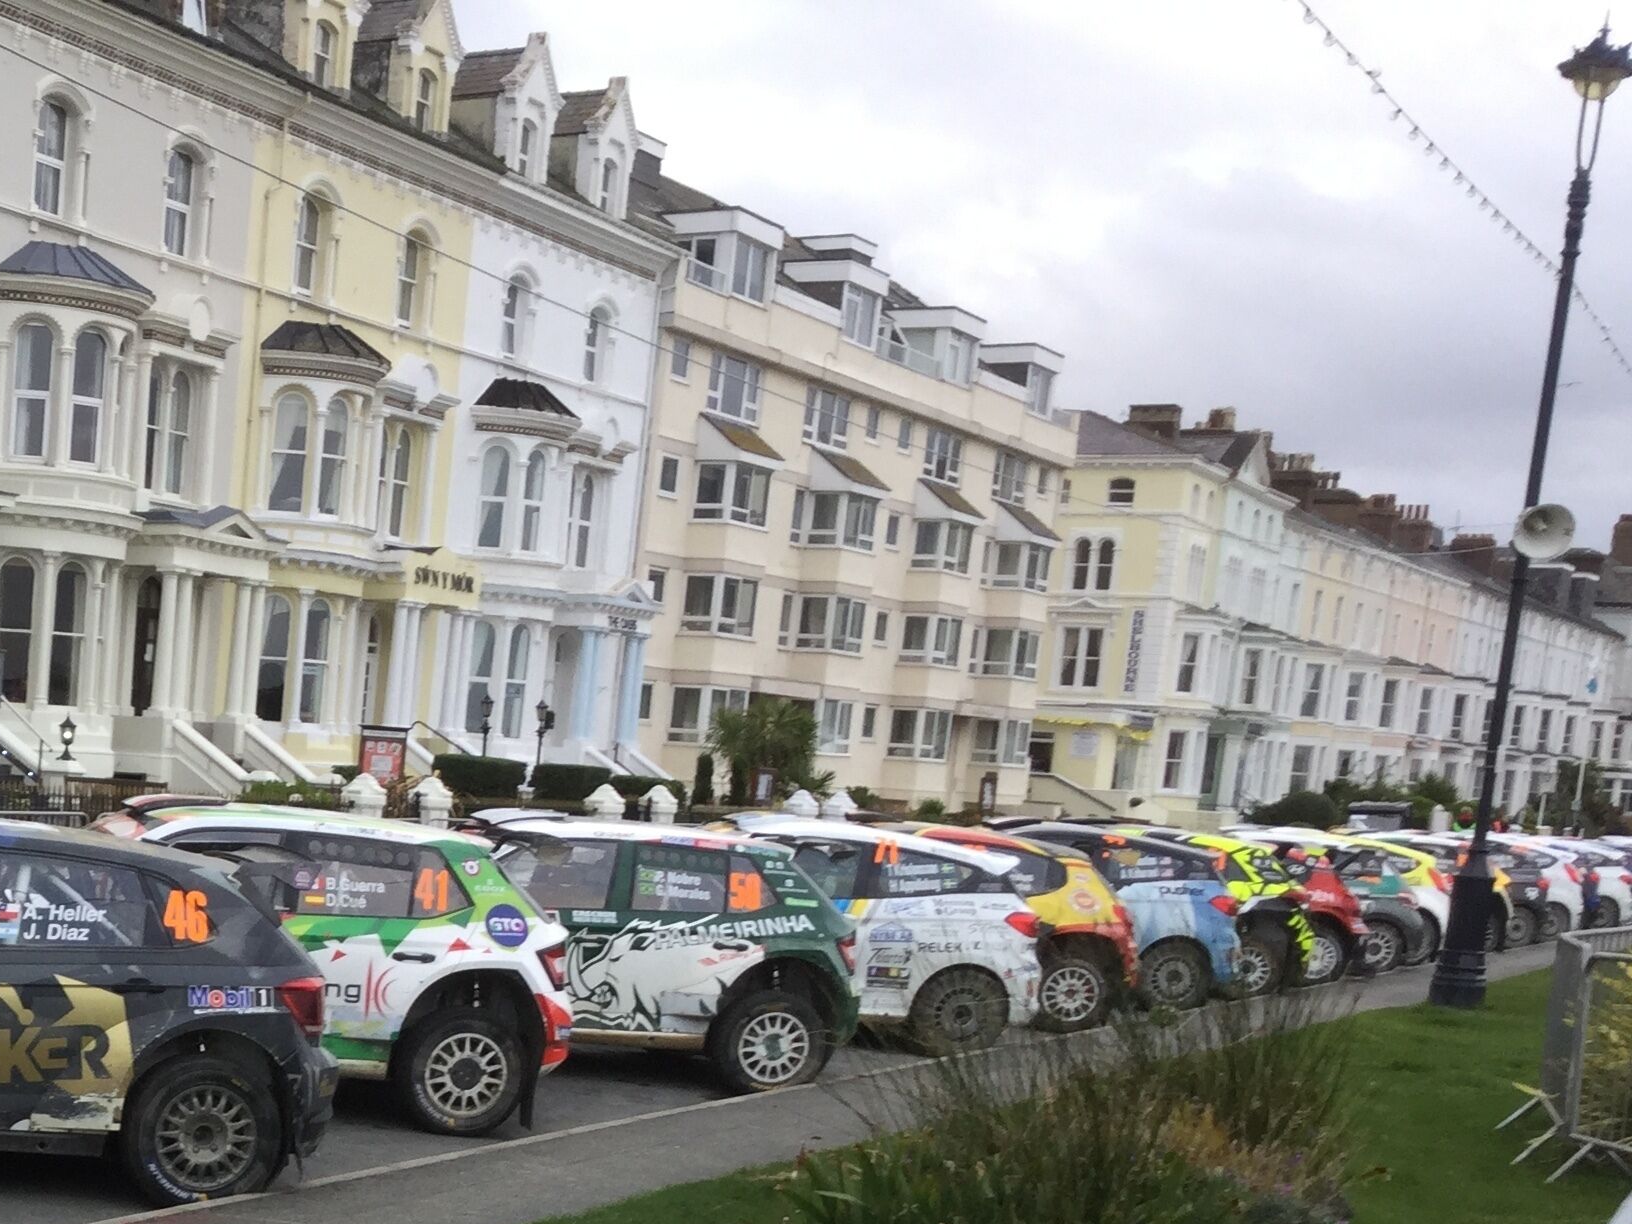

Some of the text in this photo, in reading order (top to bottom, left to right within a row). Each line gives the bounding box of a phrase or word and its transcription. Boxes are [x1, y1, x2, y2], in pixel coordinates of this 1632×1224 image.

[414, 867, 450, 912] 41
[728, 871, 762, 910] 50
[22, 902, 107, 922] A. Heller
[163, 889, 209, 943] 46
[23, 923, 90, 941] J. Diaz
[653, 913, 816, 950] PALMEIRINHA
[187, 984, 253, 1009] Mobil
[324, 982, 361, 1004] ng
